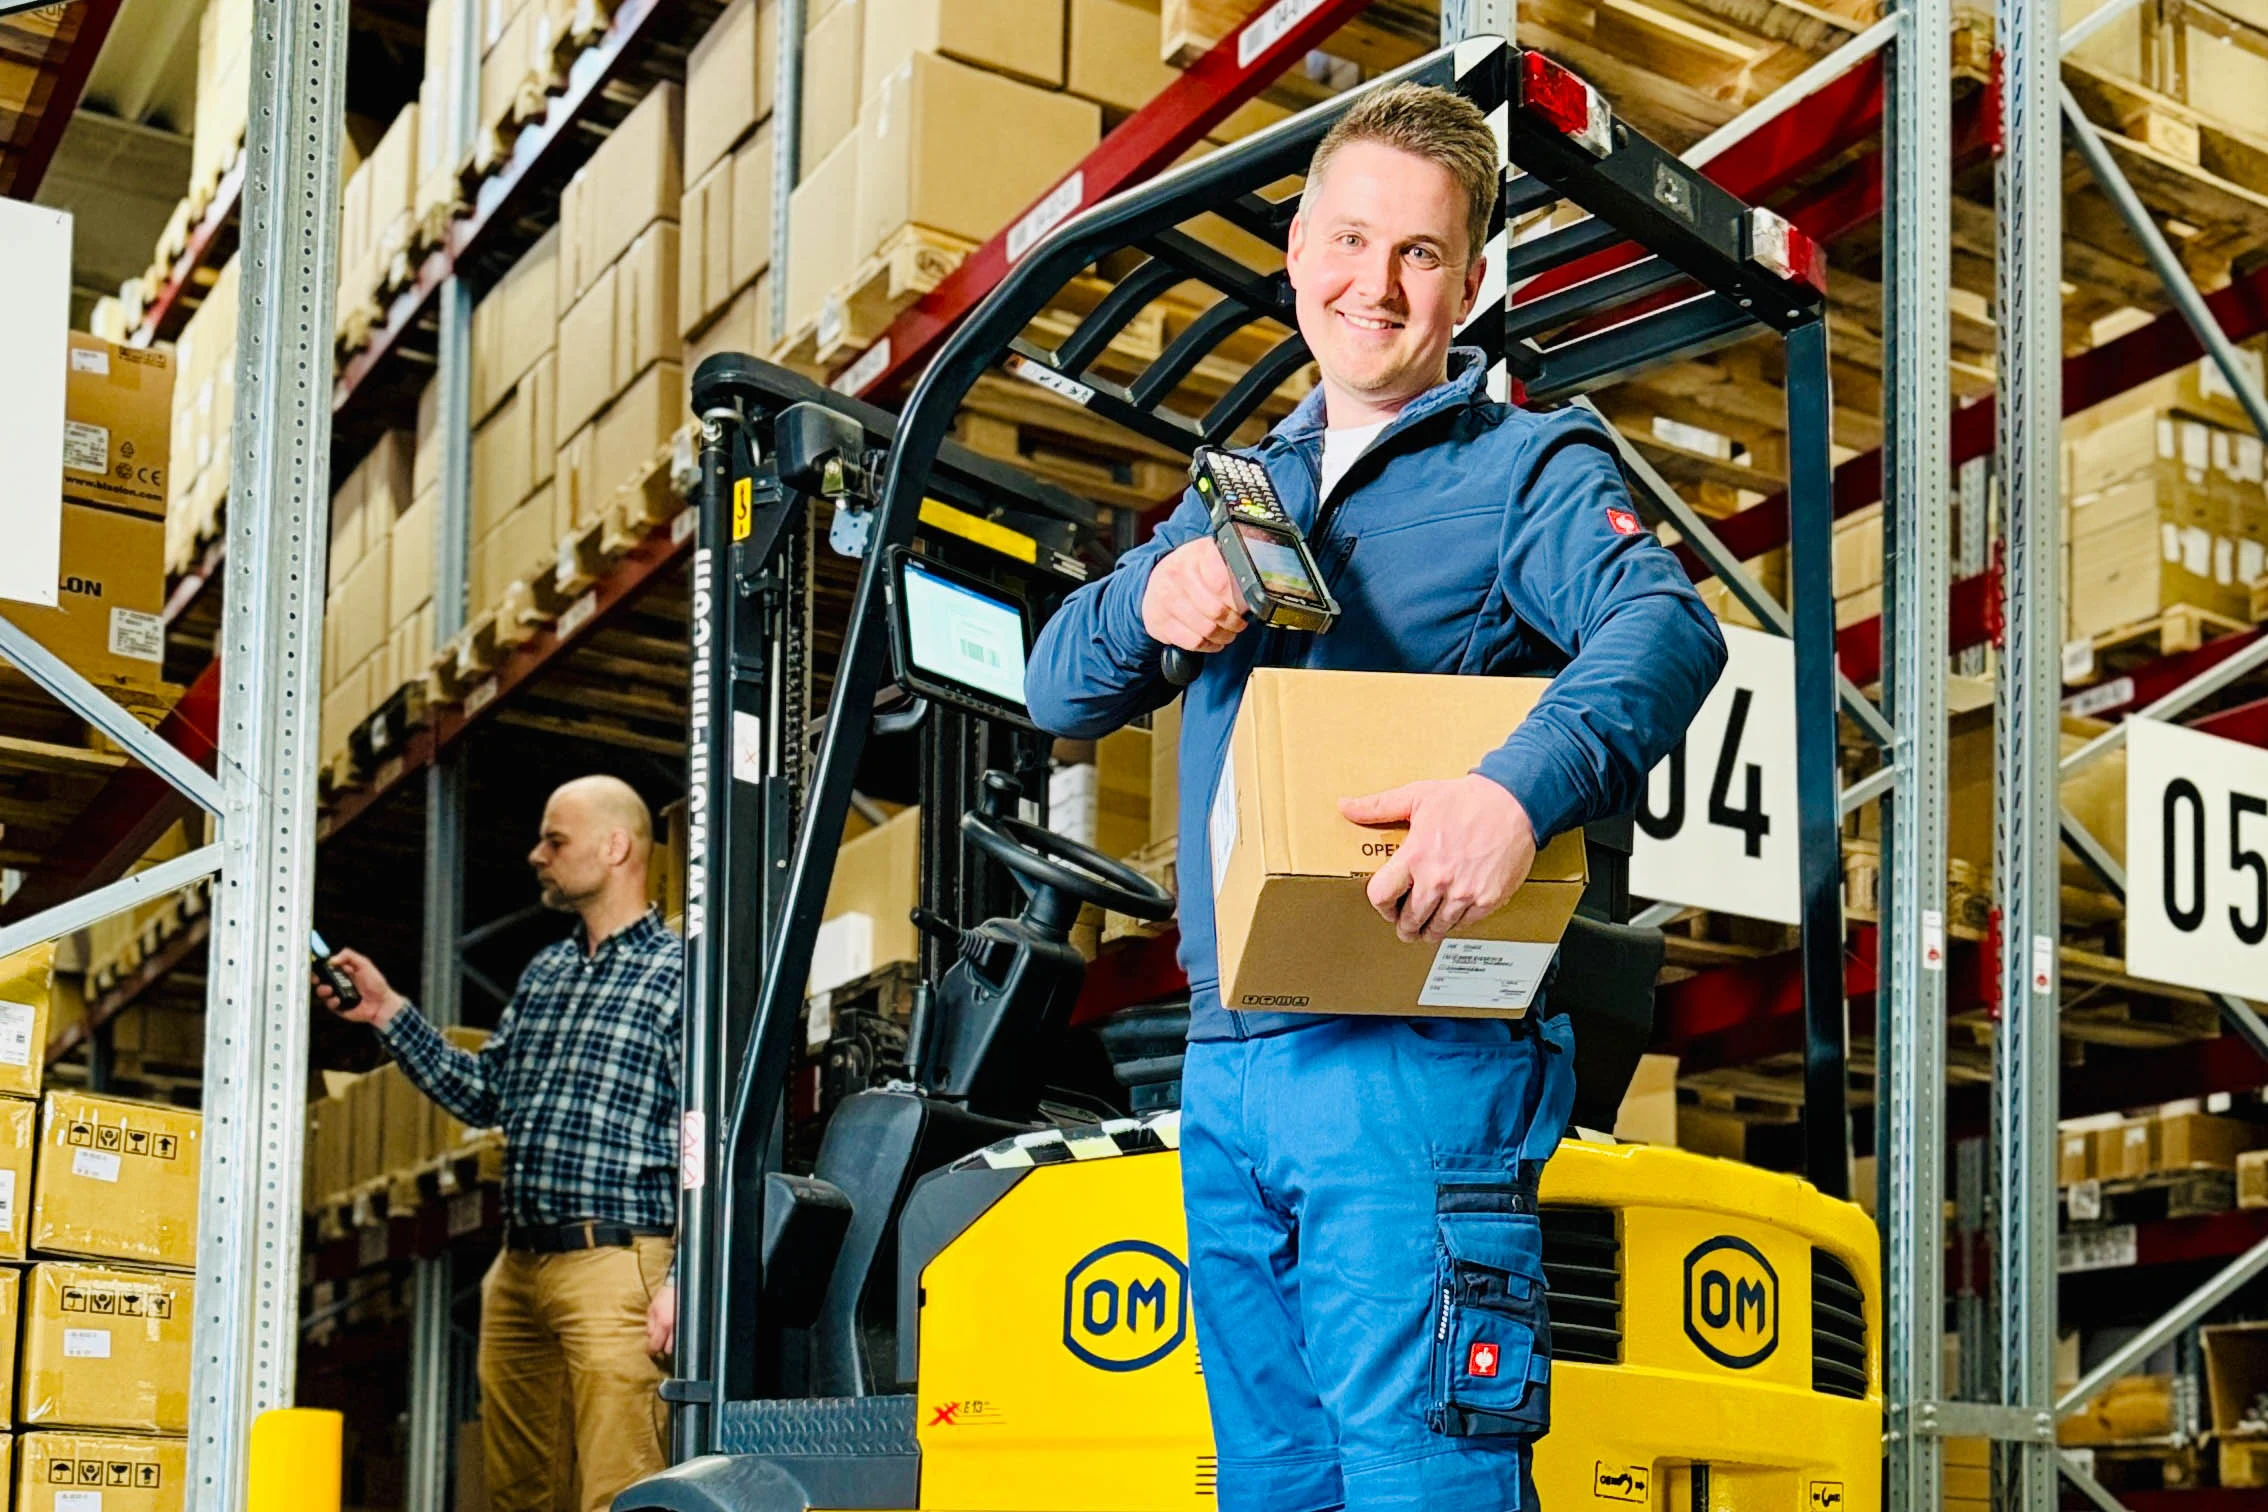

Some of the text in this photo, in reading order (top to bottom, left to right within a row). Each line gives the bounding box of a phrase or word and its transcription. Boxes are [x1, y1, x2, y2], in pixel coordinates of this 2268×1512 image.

[2163, 777, 2268, 945] 05
[1083, 1277, 1166, 1334] OM
[1701, 1269, 1765, 1335] OM
